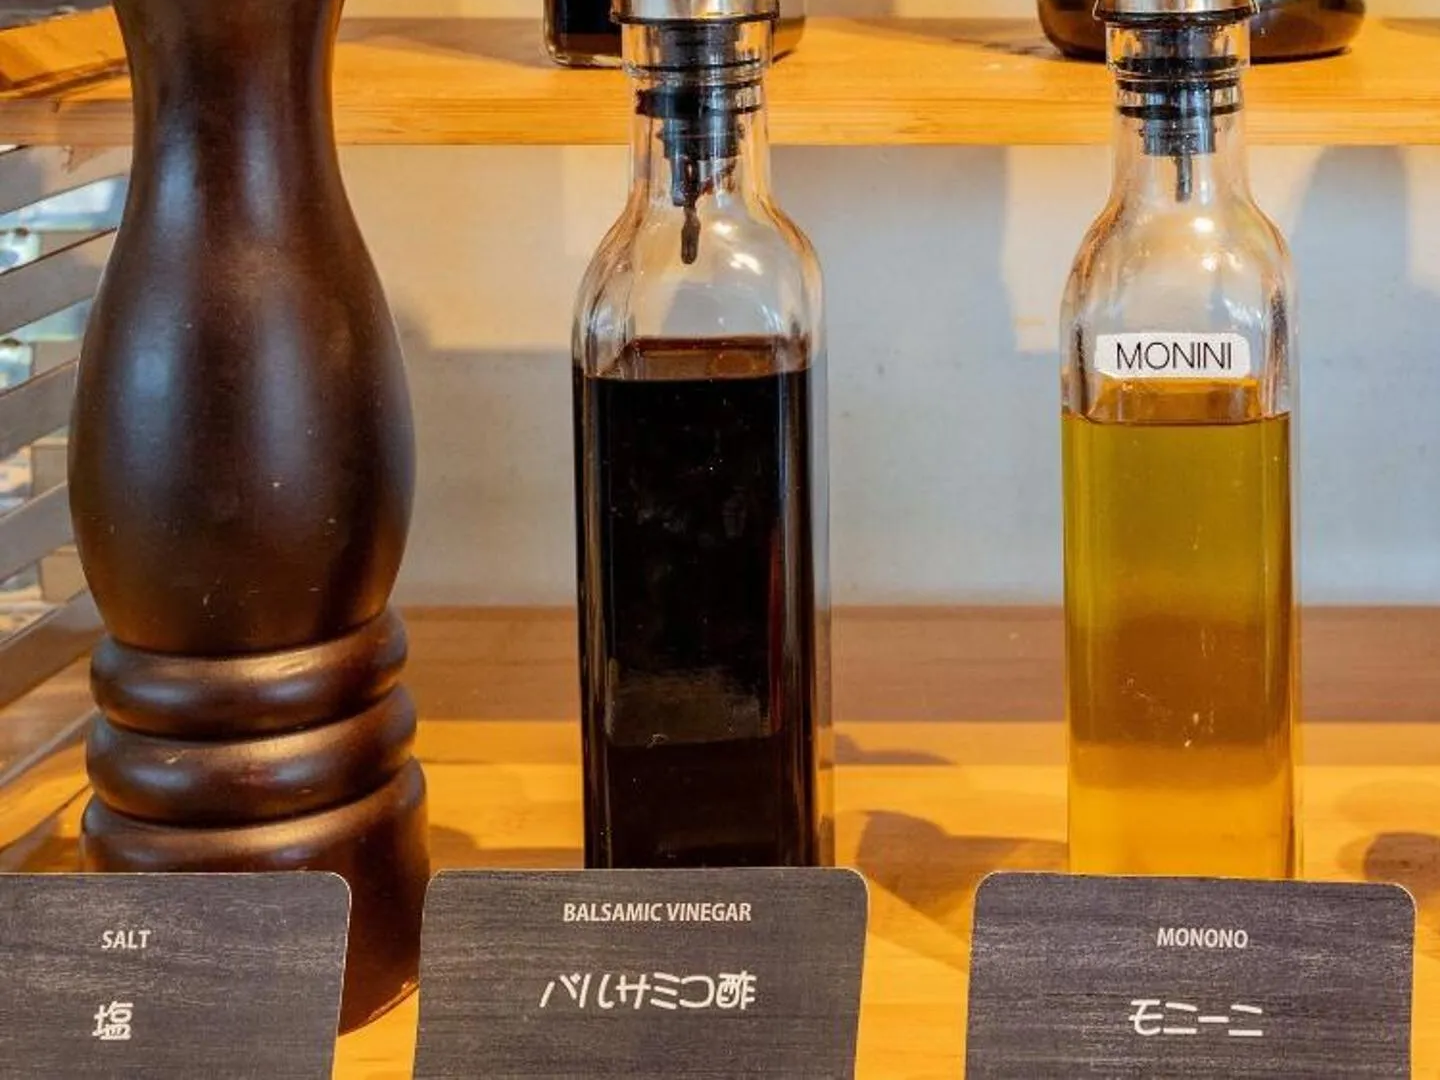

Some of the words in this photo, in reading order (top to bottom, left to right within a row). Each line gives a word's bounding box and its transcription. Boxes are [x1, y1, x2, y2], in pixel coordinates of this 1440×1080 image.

[1115, 341, 1232, 370] MONINI
[563, 902, 662, 922] BALSAMIC
[666, 902, 753, 922] VINEGAR
[101, 930, 152, 950] SALT
[1156, 926, 1249, 949] MONONO
[538, 969, 758, 1011] バルサミコ酢
[91, 999, 135, 1042] 塩
[1128, 998, 1264, 1037] モニーニ
